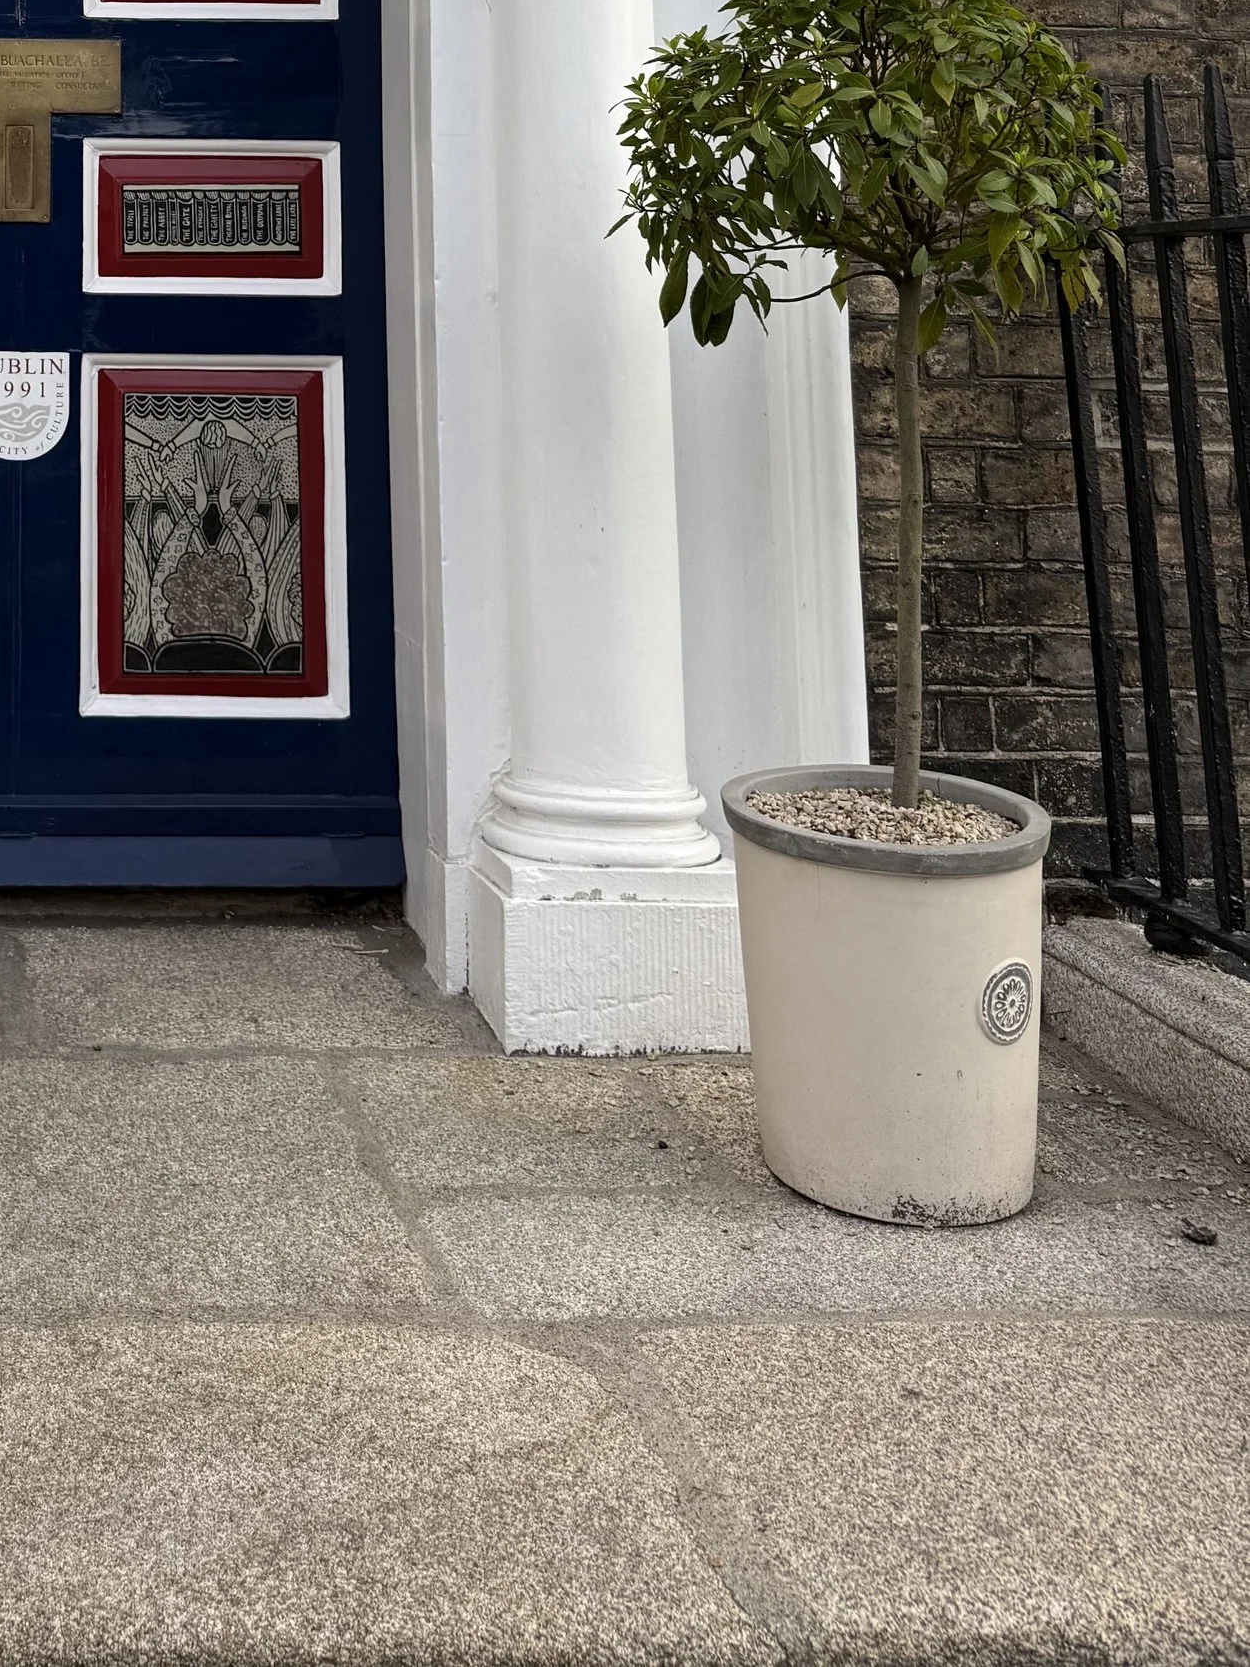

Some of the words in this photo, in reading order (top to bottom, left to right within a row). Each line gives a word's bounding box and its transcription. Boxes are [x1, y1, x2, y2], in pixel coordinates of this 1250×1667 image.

[182, 207, 190, 226] GATE
[182, 228, 190, 241] THE
[0, 445, 29, 455] CITY
[45, 382, 64, 441] CULTURE
